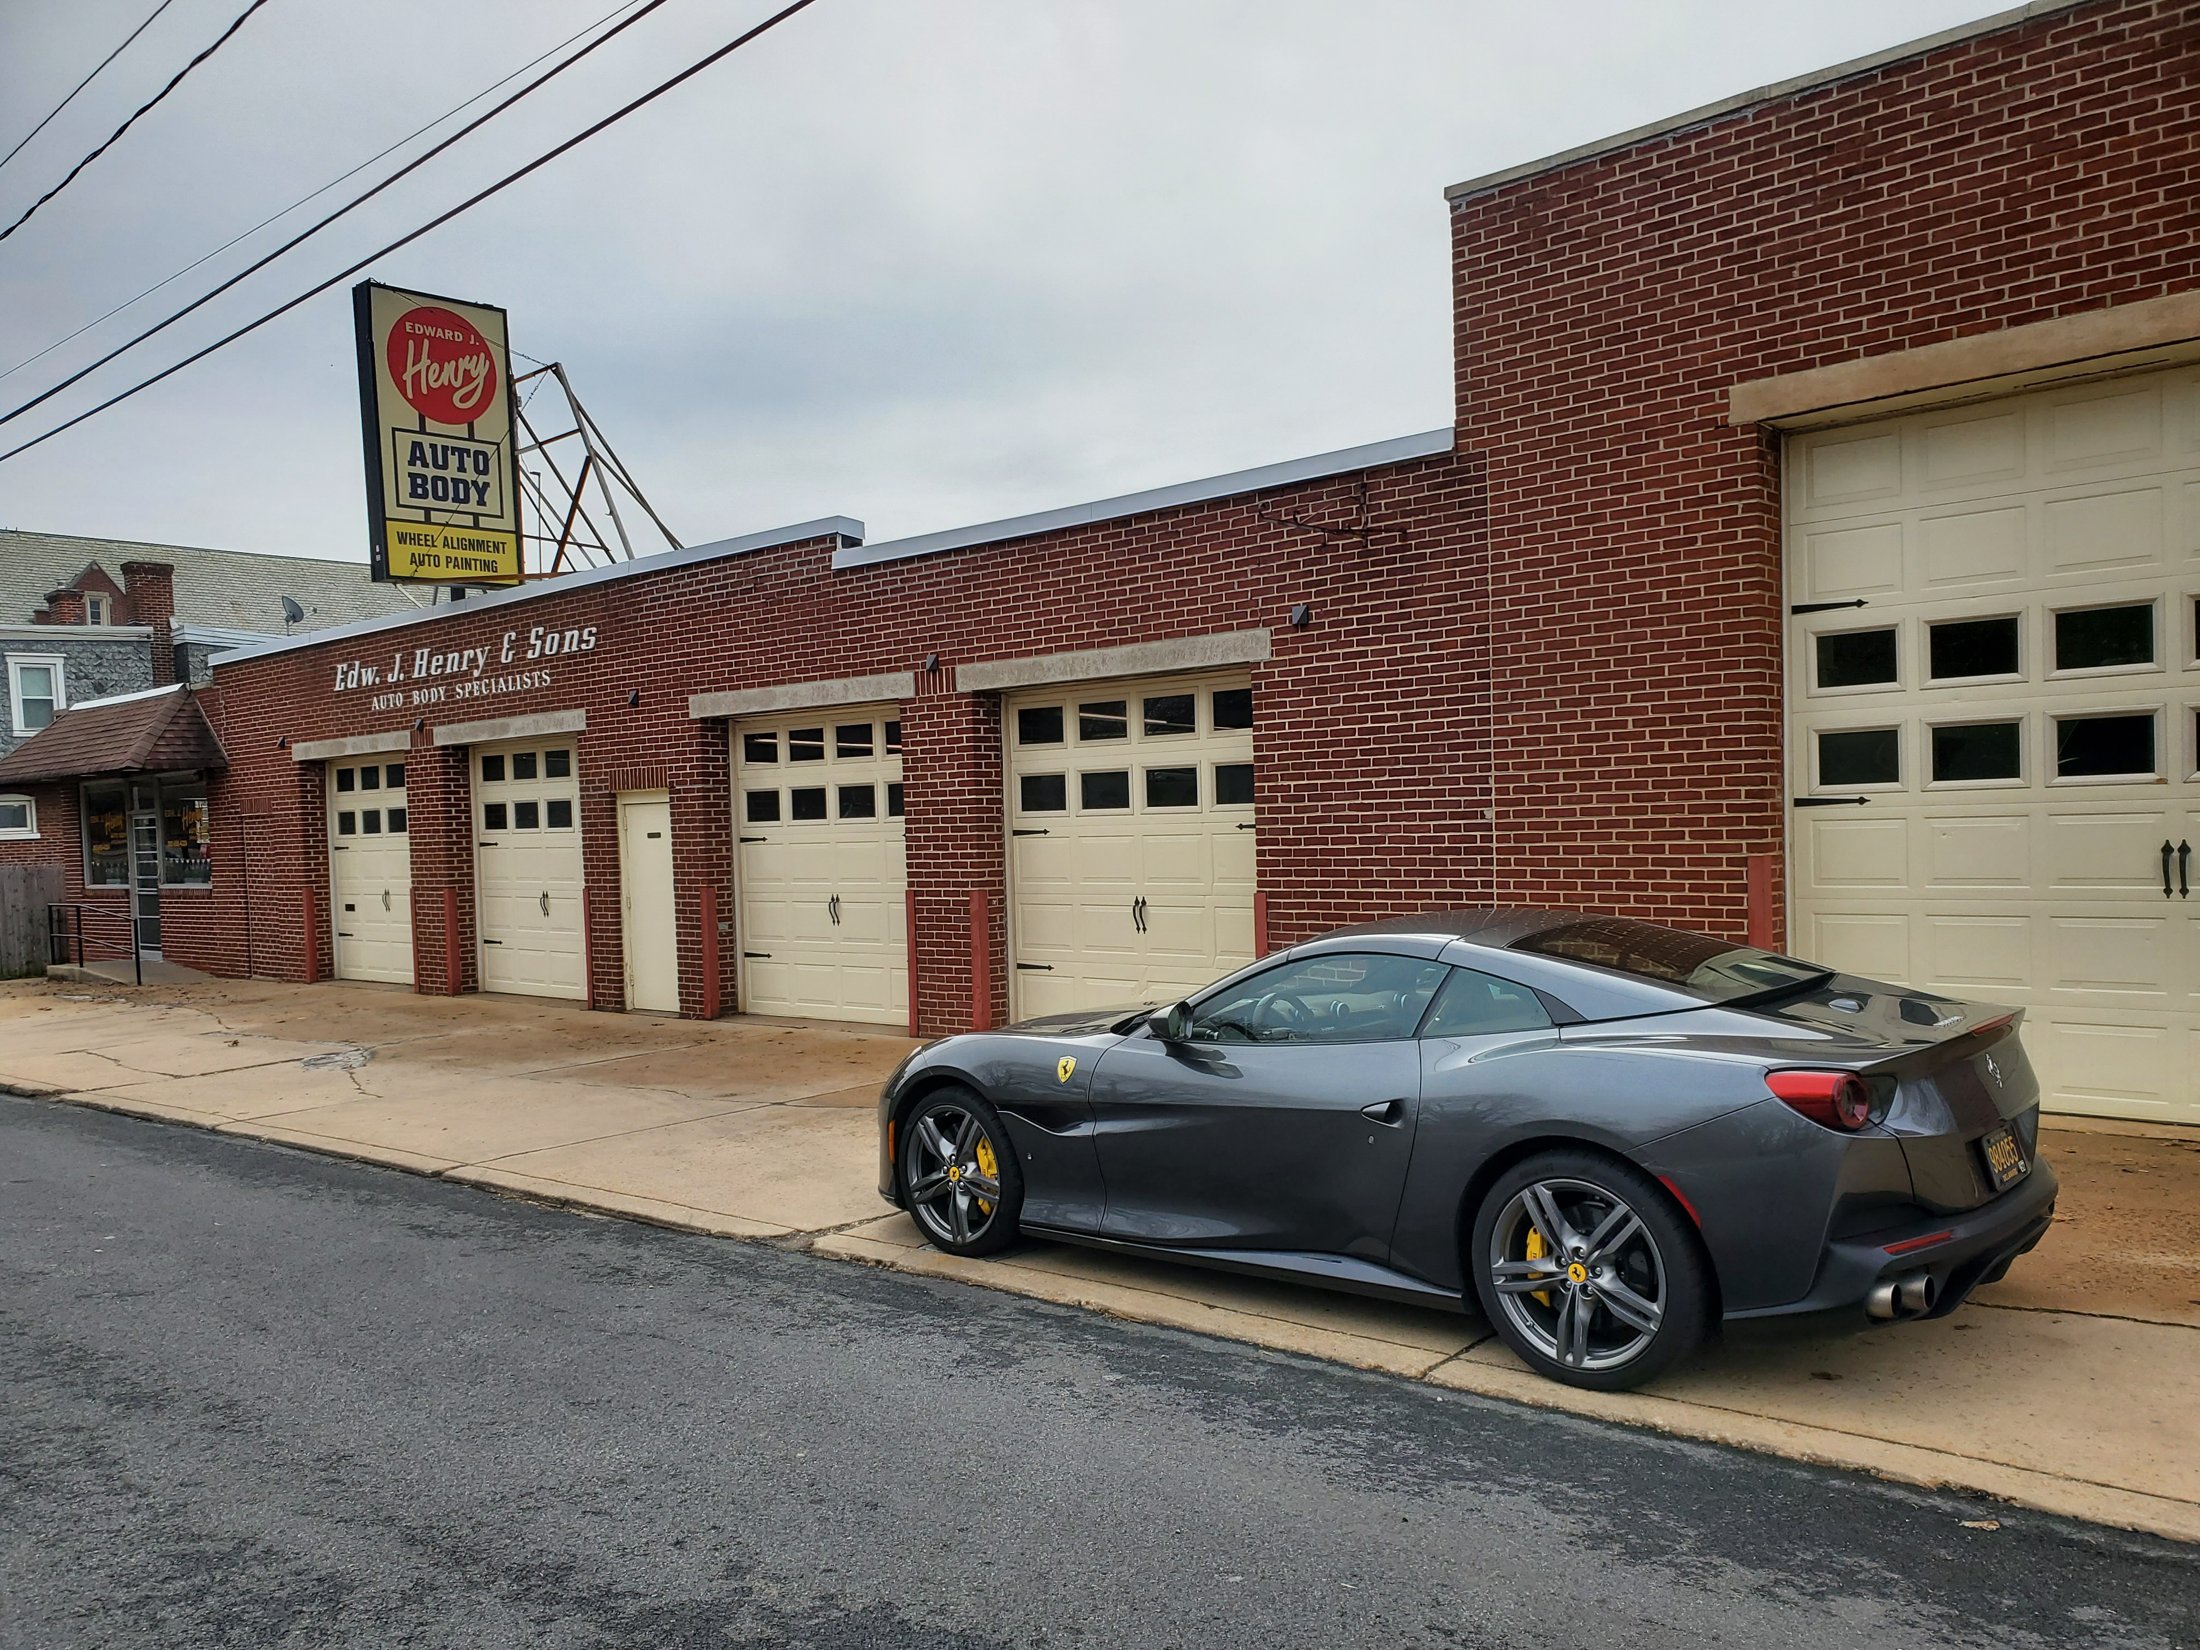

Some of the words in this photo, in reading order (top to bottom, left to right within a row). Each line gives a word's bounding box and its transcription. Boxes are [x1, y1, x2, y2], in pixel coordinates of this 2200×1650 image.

[405, 321, 463, 342] EDWARD
[469, 334, 480, 346] J.
[402, 338, 490, 409] Henry
[407, 440, 490, 476] AUTO
[407, 472, 491, 507] BODY
[396, 530, 438, 549] WHEEL
[442, 536, 507, 555] ALIGNMENT
[409, 551, 440, 568] AUTO
[445, 555, 498, 573] PAINTING
[333, 660, 381, 692] Edw.
[387, 653, 405, 683] J.
[412, 645, 491, 679] Henry
[527, 626, 598, 660] Sons
[371, 692, 403, 711] AUTO
[413, 685, 447, 705] BODY
[455, 669, 551, 699] SPECIALISTS
